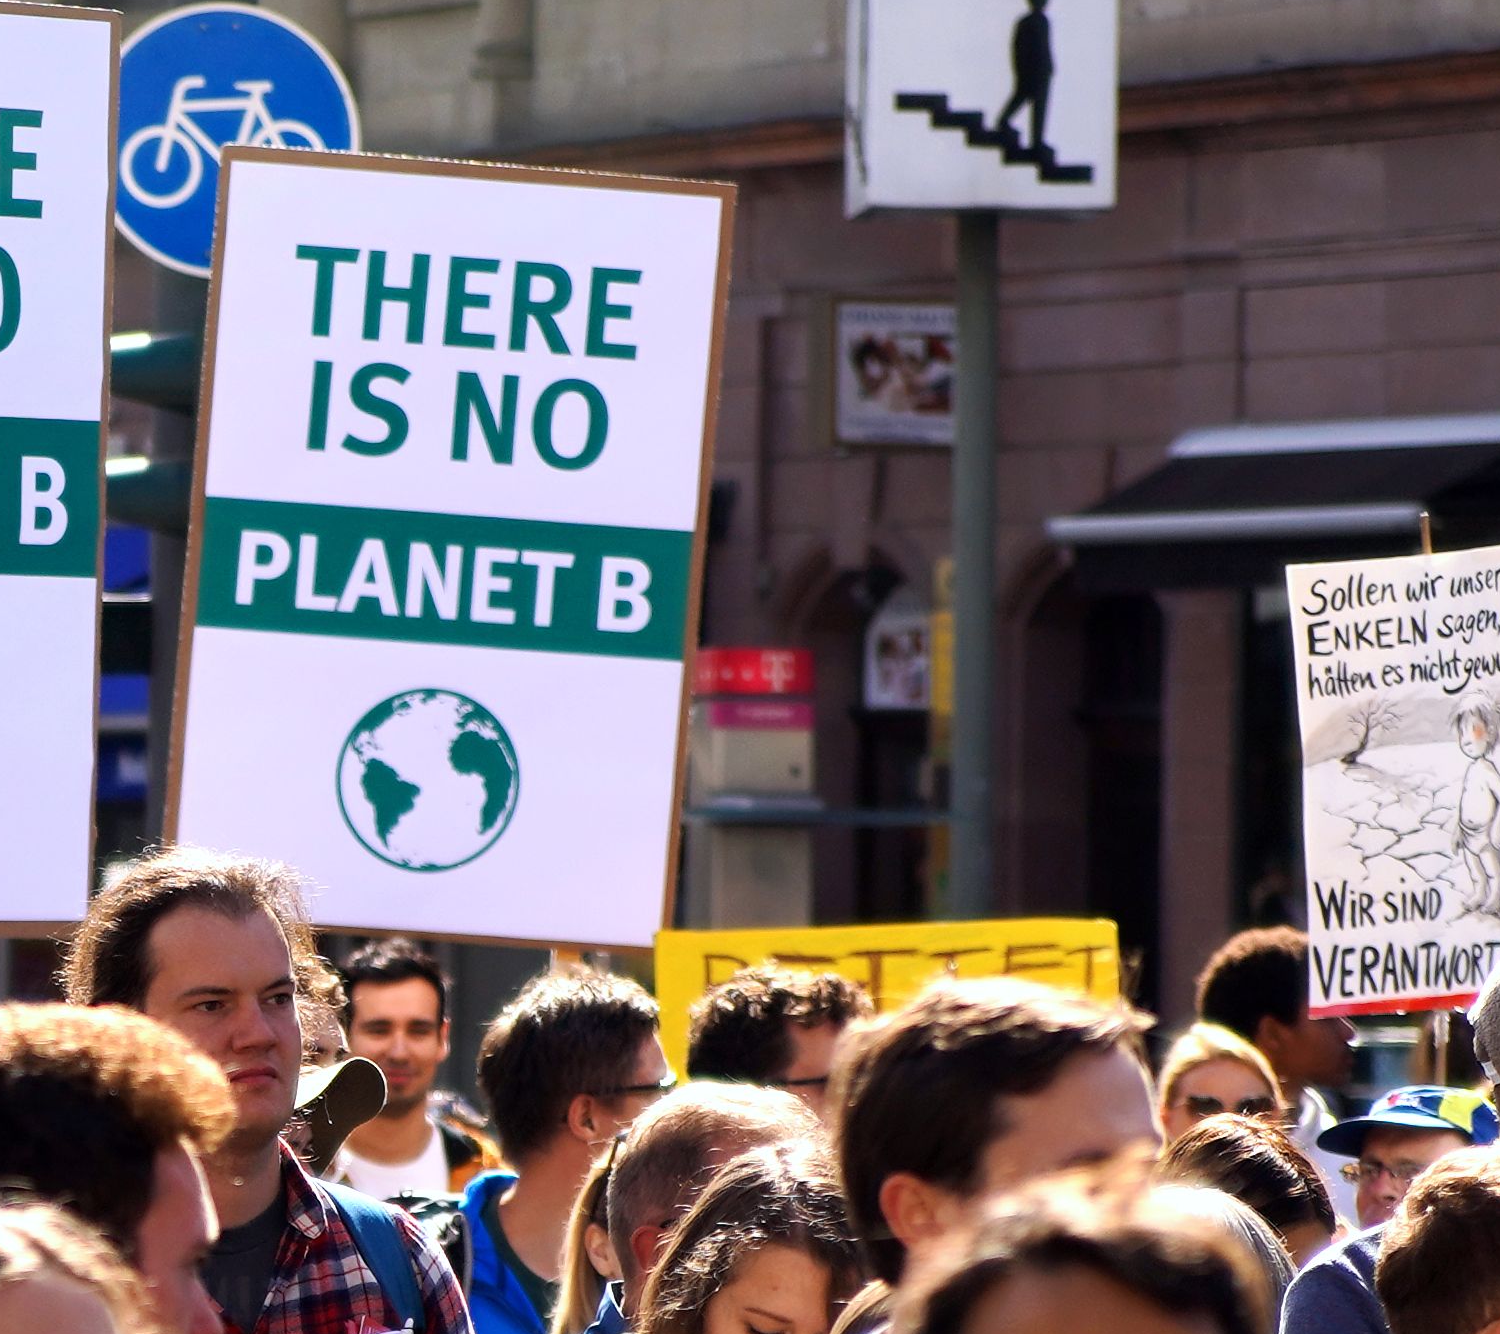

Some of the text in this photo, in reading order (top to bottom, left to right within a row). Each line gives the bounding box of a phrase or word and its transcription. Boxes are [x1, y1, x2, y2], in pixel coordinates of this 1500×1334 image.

[295, 244, 644, 361] THERE
[307, 359, 609, 472] IS NO
[19, 456, 69, 547] B
[234, 528, 654, 635] PLANET B
[1302, 573, 1397, 616] Sollen
[1406, 572, 1443, 603] wir
[1308, 610, 1428, 657] ENKELN
[1308, 661, 1377, 700] hätten
[1381, 664, 1405, 687] es
[1410, 649, 1460, 683] nicht
